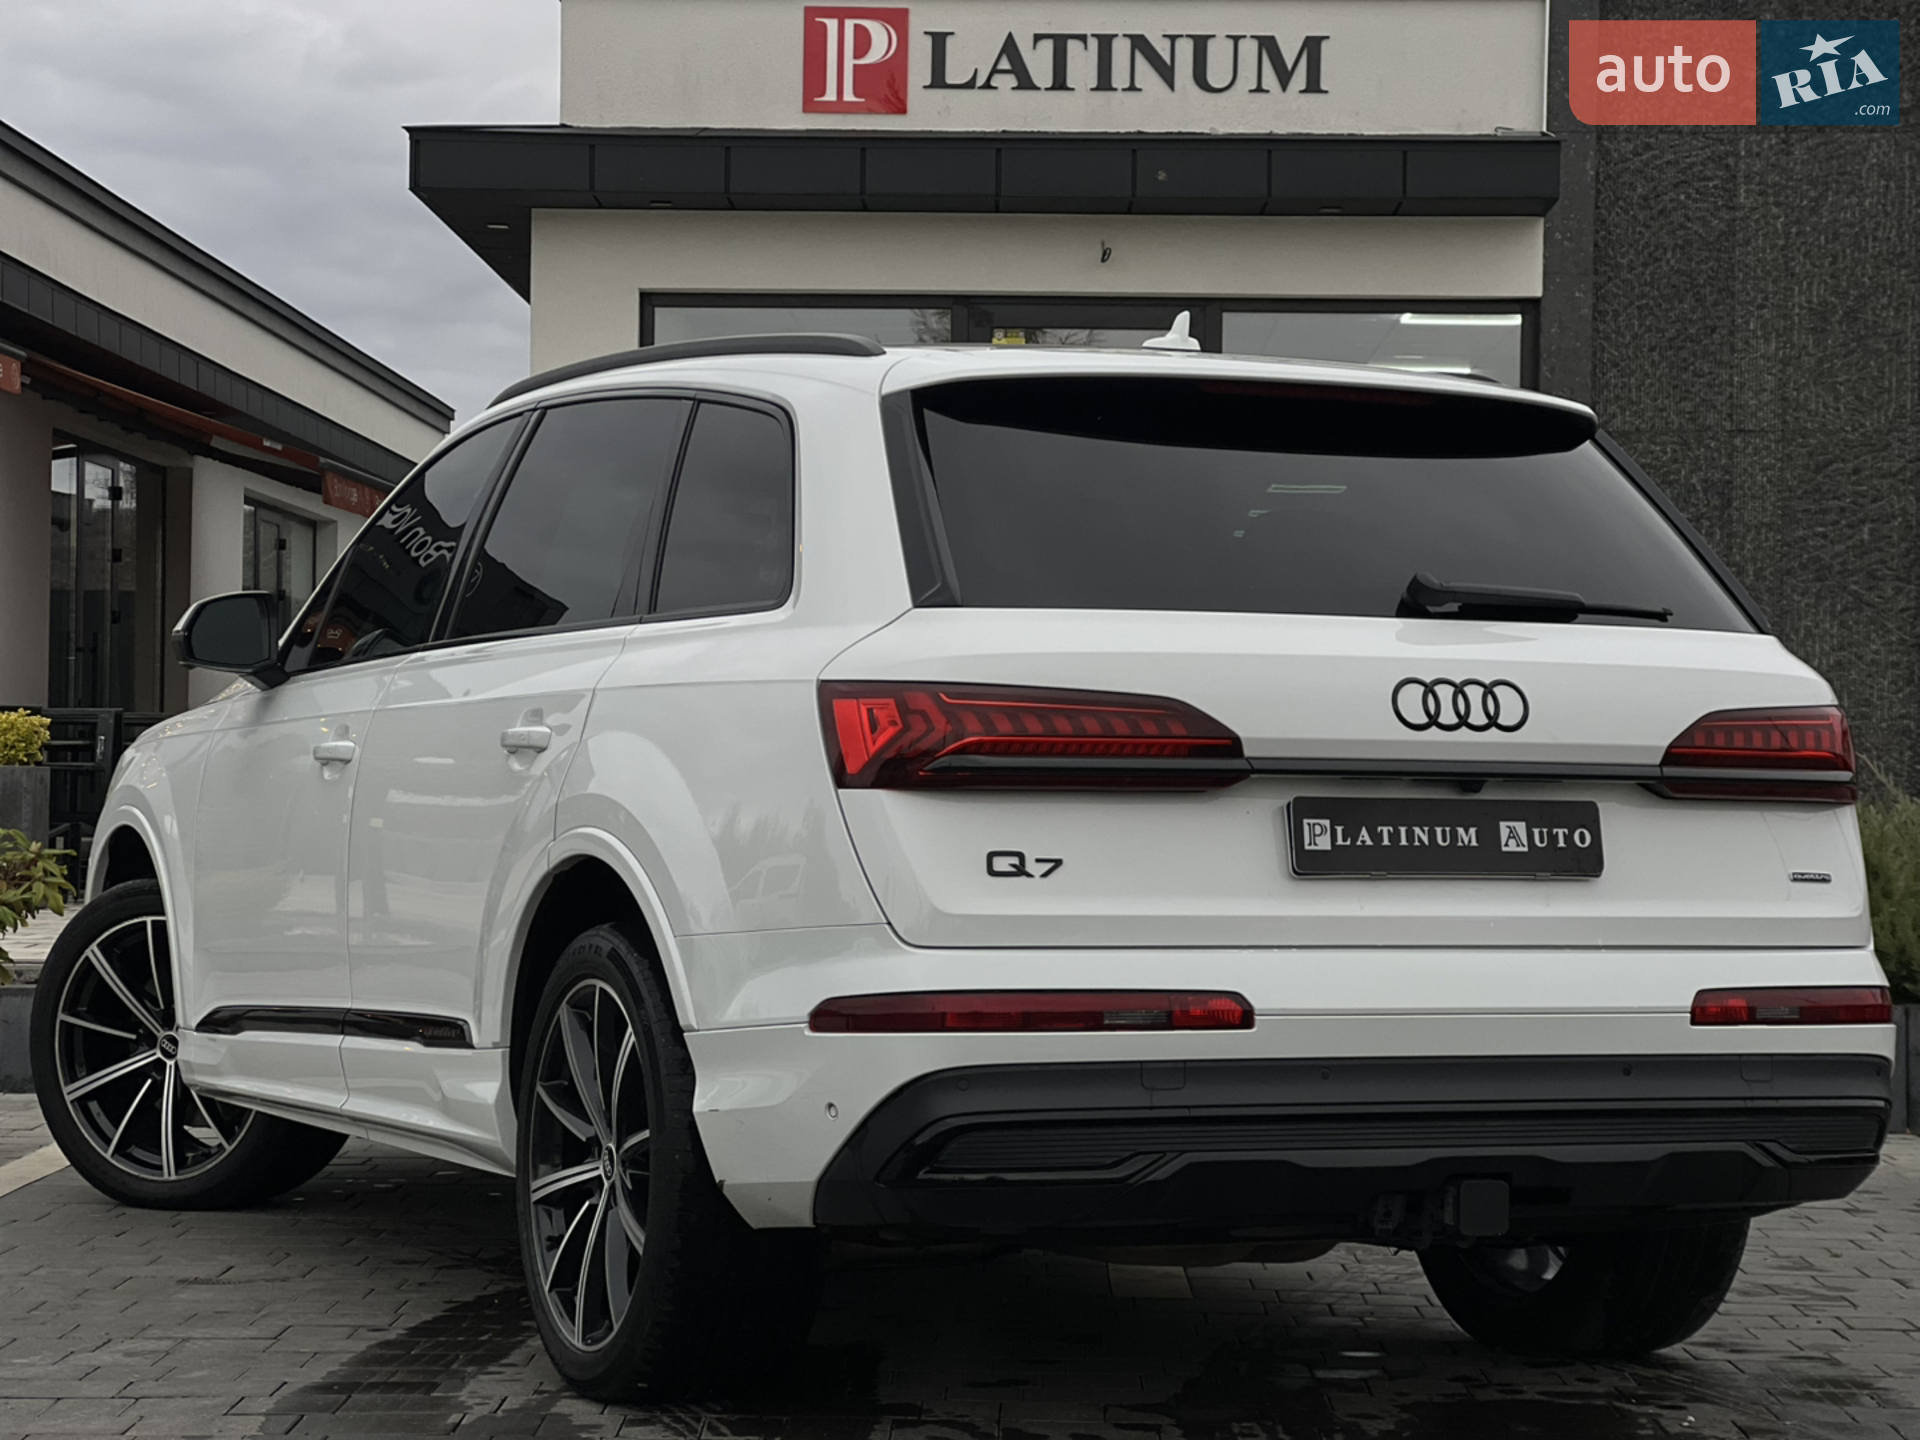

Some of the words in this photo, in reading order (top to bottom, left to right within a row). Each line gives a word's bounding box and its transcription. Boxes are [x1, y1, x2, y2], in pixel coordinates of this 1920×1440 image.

[1303, 819, 1479, 850] PLATINUM
[1500, 821, 1592, 852] AUTO
[986, 850, 1063, 878] Q7
